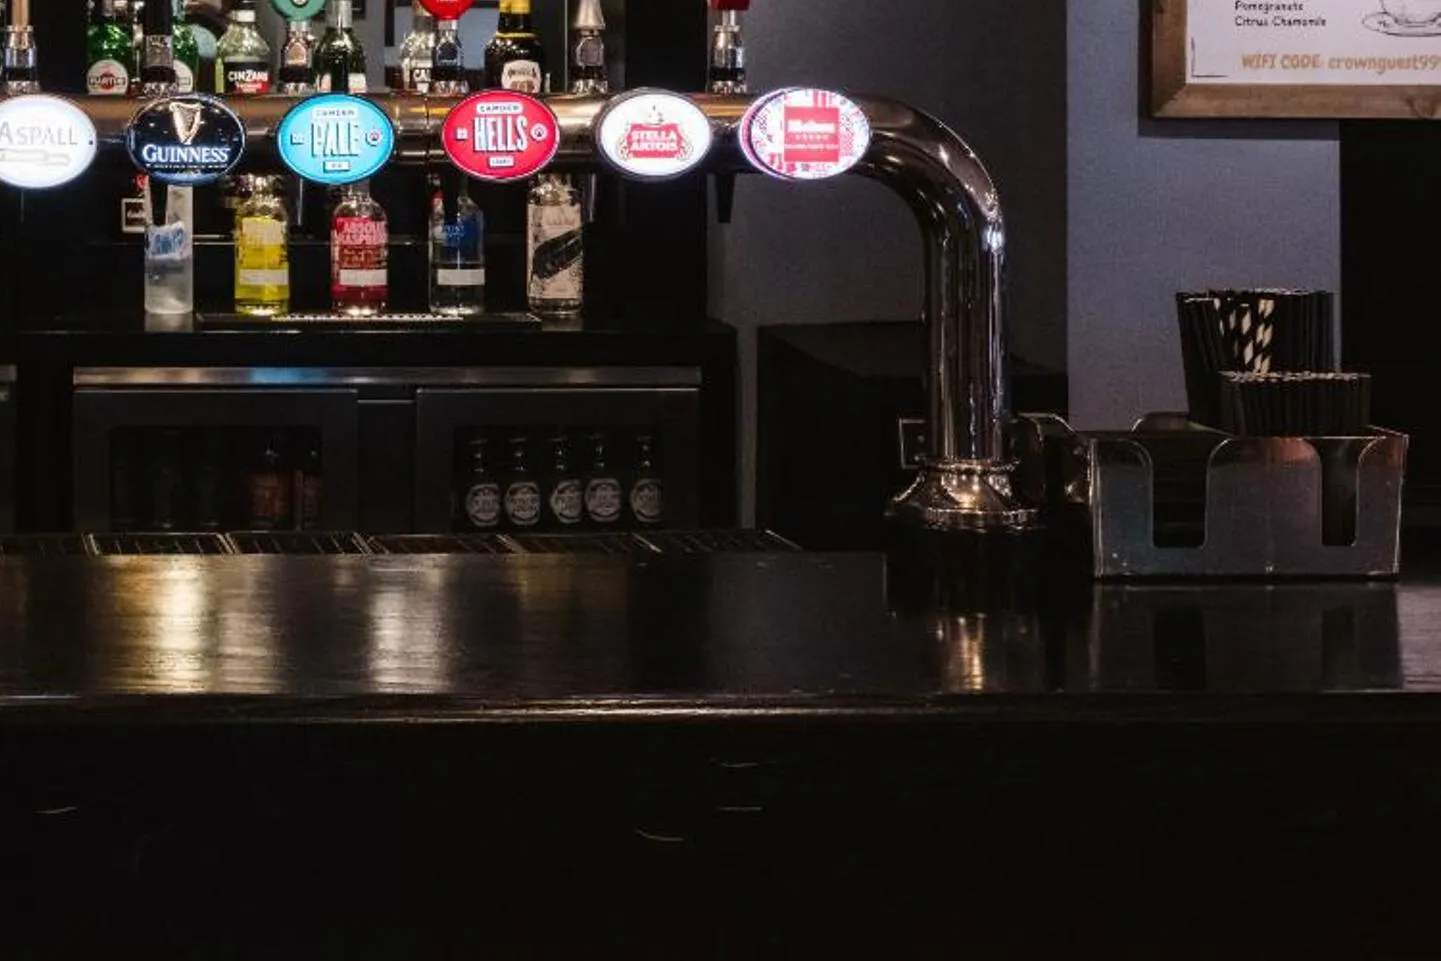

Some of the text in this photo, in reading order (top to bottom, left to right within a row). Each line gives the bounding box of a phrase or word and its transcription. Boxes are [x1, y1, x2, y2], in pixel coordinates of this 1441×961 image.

[1235, 0, 1303, 14] Pomegranate
[1235, 16, 1268, 27] Citrus
[1241, 53, 1441, 75] WIFI CODE crownguest99
[311, 121, 360, 158] PALE
[474, 115, 528, 152] HELLS
[631, 130, 678, 141] STELLA
[142, 144, 231, 163] GUINNESS
[630, 141, 678, 151] ARTOIS
